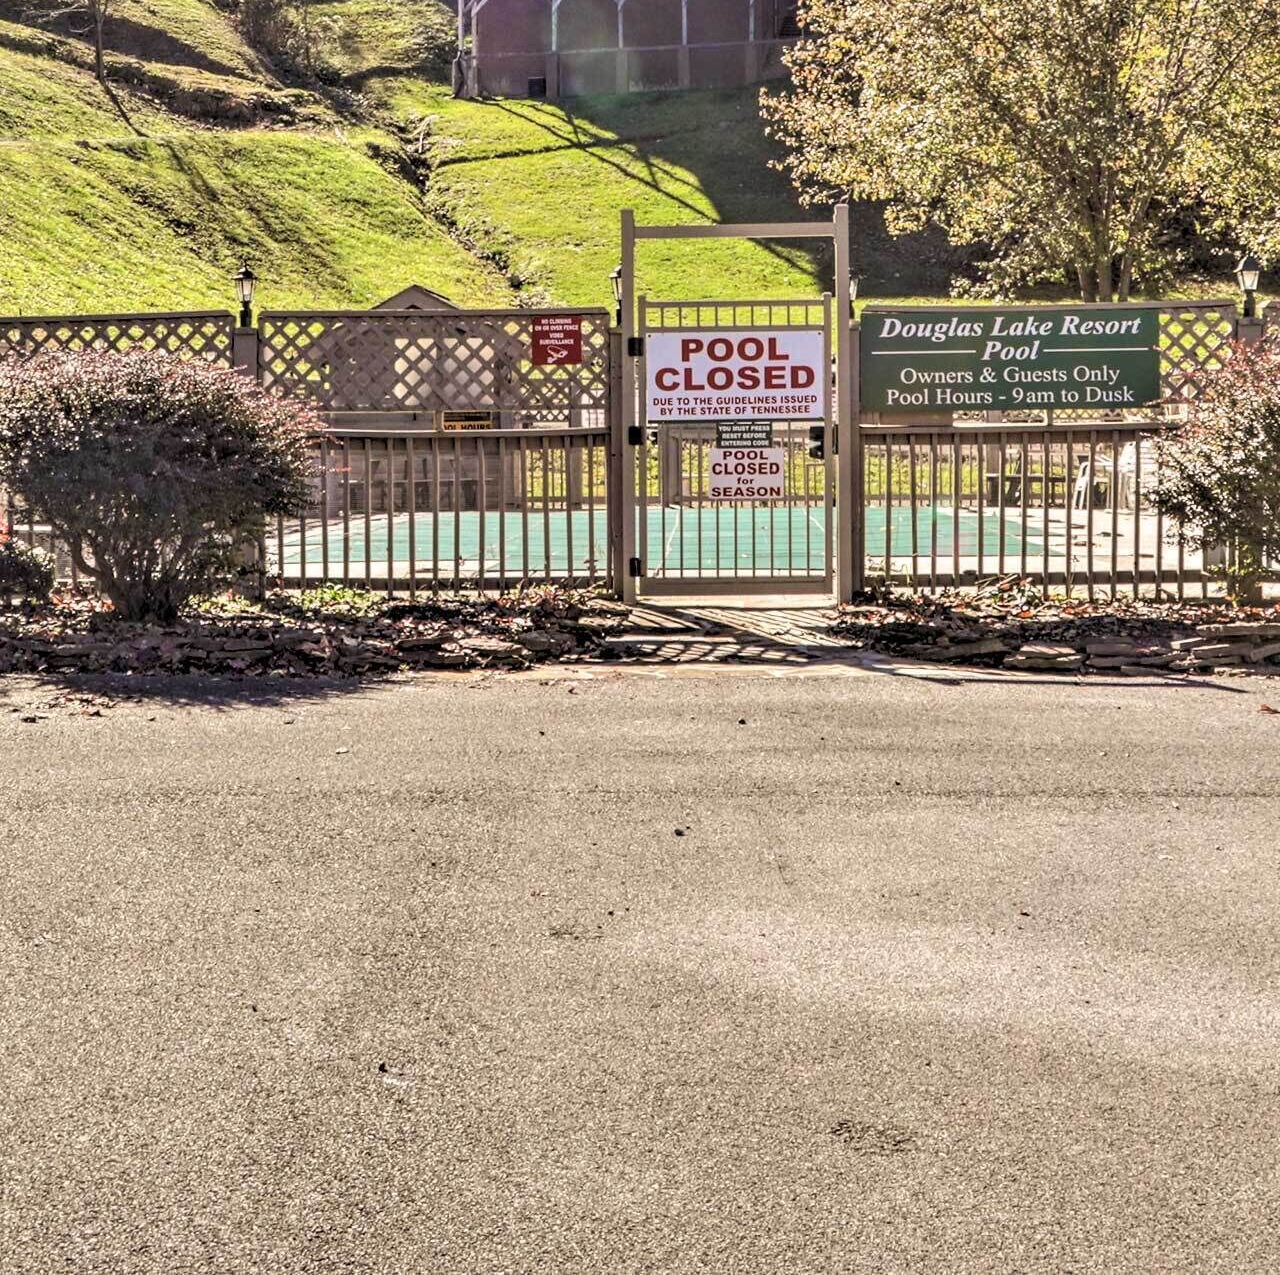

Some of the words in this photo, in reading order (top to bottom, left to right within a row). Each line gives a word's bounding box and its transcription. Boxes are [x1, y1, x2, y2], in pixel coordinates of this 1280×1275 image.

[879, 317, 984, 342] Douglas
[990, 316, 1053, 336] Lake
[1059, 315, 1142, 335] Resort
[681, 337, 789, 362] POOL
[981, 340, 1040, 361] Pool
[654, 366, 815, 391] CLOSED
[900, 367, 973, 384] Owners
[979, 367, 997, 383] &
[1003, 366, 1067, 382] Guests
[1073, 365, 1120, 385] Only
[653, 398, 673, 406] DUE
[677, 397, 690, 406] TO
[693, 397, 713, 406] THE
[716, 396, 777, 405] GUIDELINES
[780, 395, 817, 404] ISSUED
[886, 388, 929, 405] Pool
[935, 388, 993, 404] Hours
[1012, 387, 1055, 403] 9am
[1061, 389, 1079, 402] to
[1086, 386, 1135, 402] Dusk
[660, 407, 674, 416] BY
[677, 407, 697, 415] THE
[700, 407, 731, 415] STATE
[734, 406, 747, 415] OF
[751, 405, 810, 414] TENNESSEE
[723, 450, 769, 460] POOL
[712, 462, 780, 475] CLOSED
[737, 476, 754, 484] for
[711, 486, 781, 497] SEASON
